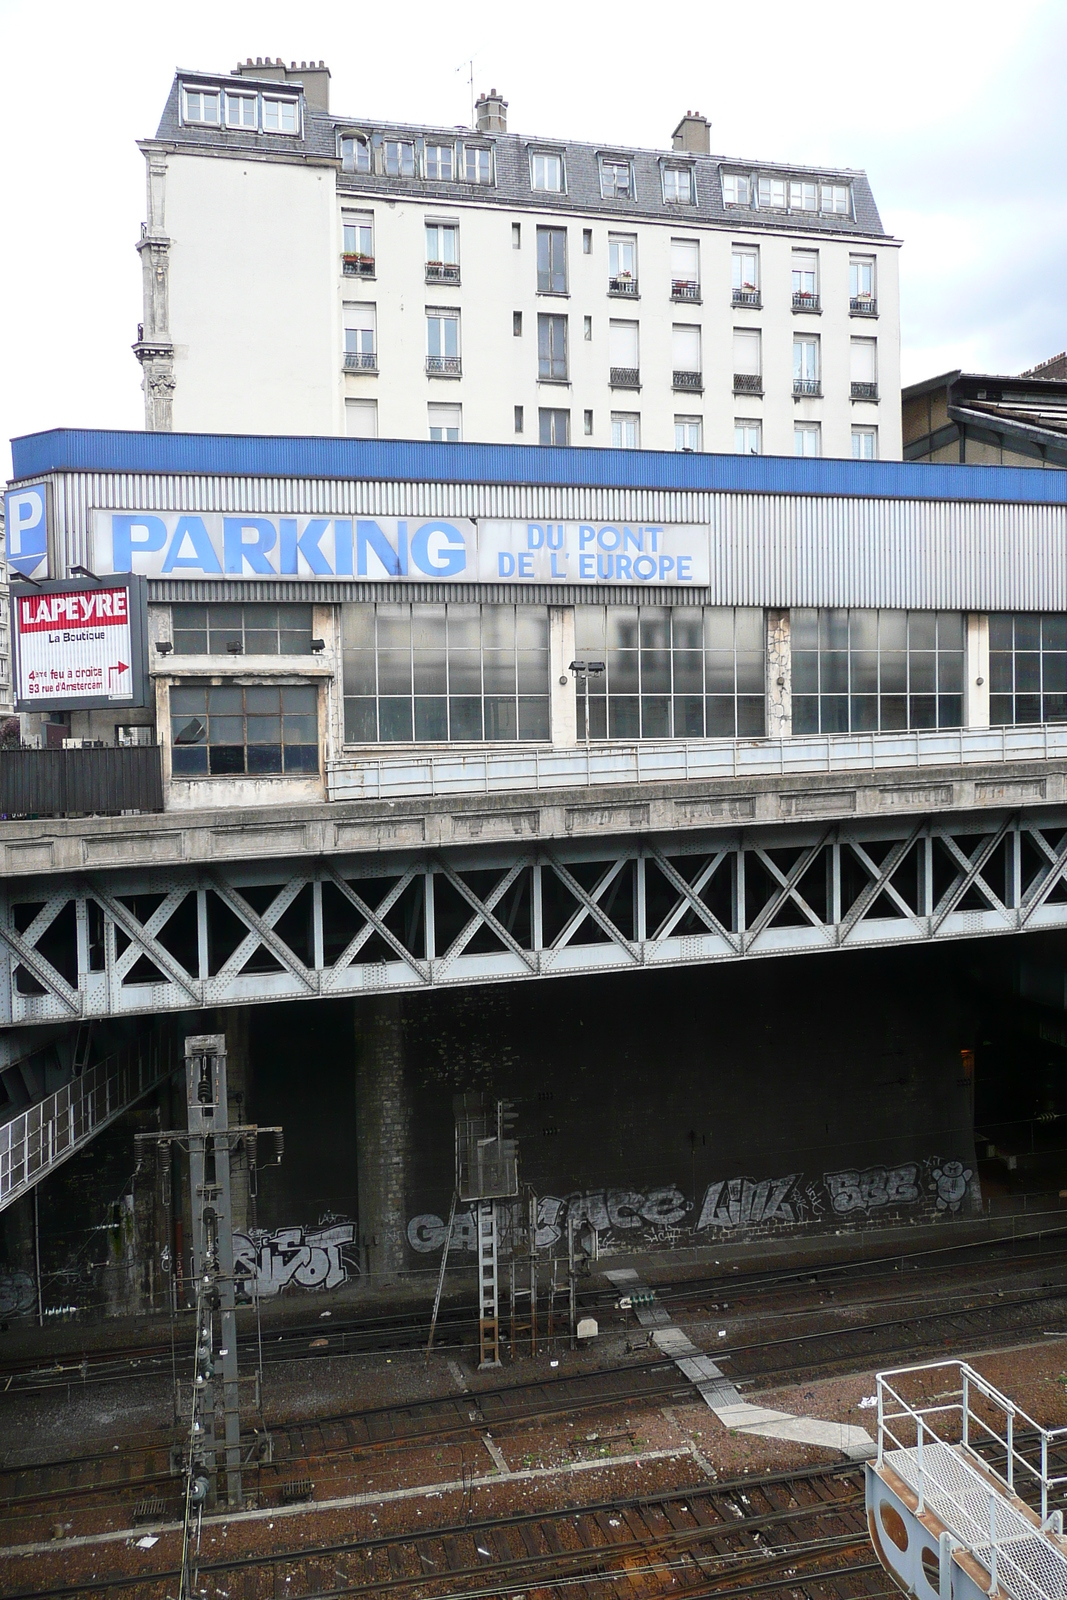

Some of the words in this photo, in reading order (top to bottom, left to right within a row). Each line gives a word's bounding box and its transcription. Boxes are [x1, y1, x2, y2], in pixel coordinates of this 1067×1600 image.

[9, 491, 43, 554] P
[112, 515, 466, 578] PARKING
[527, 524, 564, 550] DU
[579, 525, 664, 553] PONT
[498, 552, 535, 578] DE
[551, 553, 693, 581] L'EUROPE
[22, 592, 127, 625] LAPEYRE
[49, 633, 60, 643] La
[63, 631, 105, 642] Boutique
[42, 684, 53, 693] rue
[55, 681, 103, 692] d'Amsterdam
[50, 669, 64, 679] feu
[67, 667, 73, 678] à
[75, 666, 102, 678] droite
